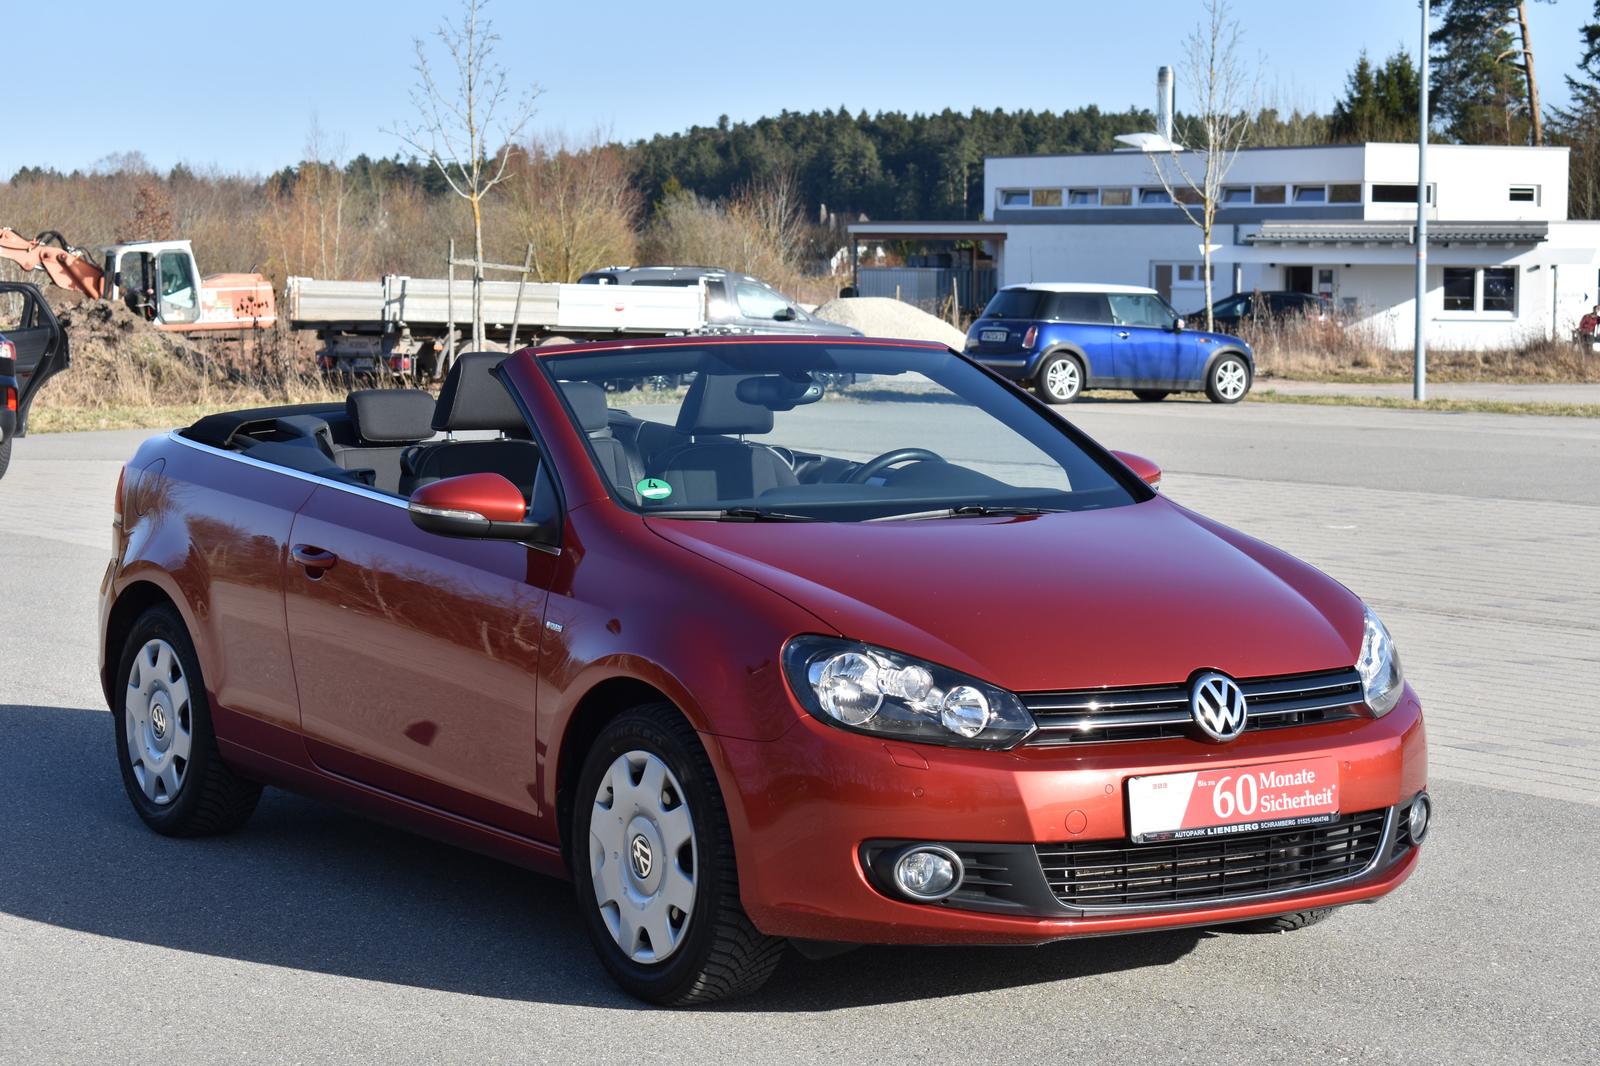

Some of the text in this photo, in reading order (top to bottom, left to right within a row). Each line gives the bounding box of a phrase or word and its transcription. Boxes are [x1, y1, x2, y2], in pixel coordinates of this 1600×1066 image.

[648, 480, 658, 489] 4
[1259, 769, 1315, 789] Monate
[1213, 774, 1258, 818] 60
[1174, 829, 1206, 838] AUTOPARK
[1206, 823, 1259, 835] LIENBERG
[1260, 819, 1296, 829] SCHRAMBERG
